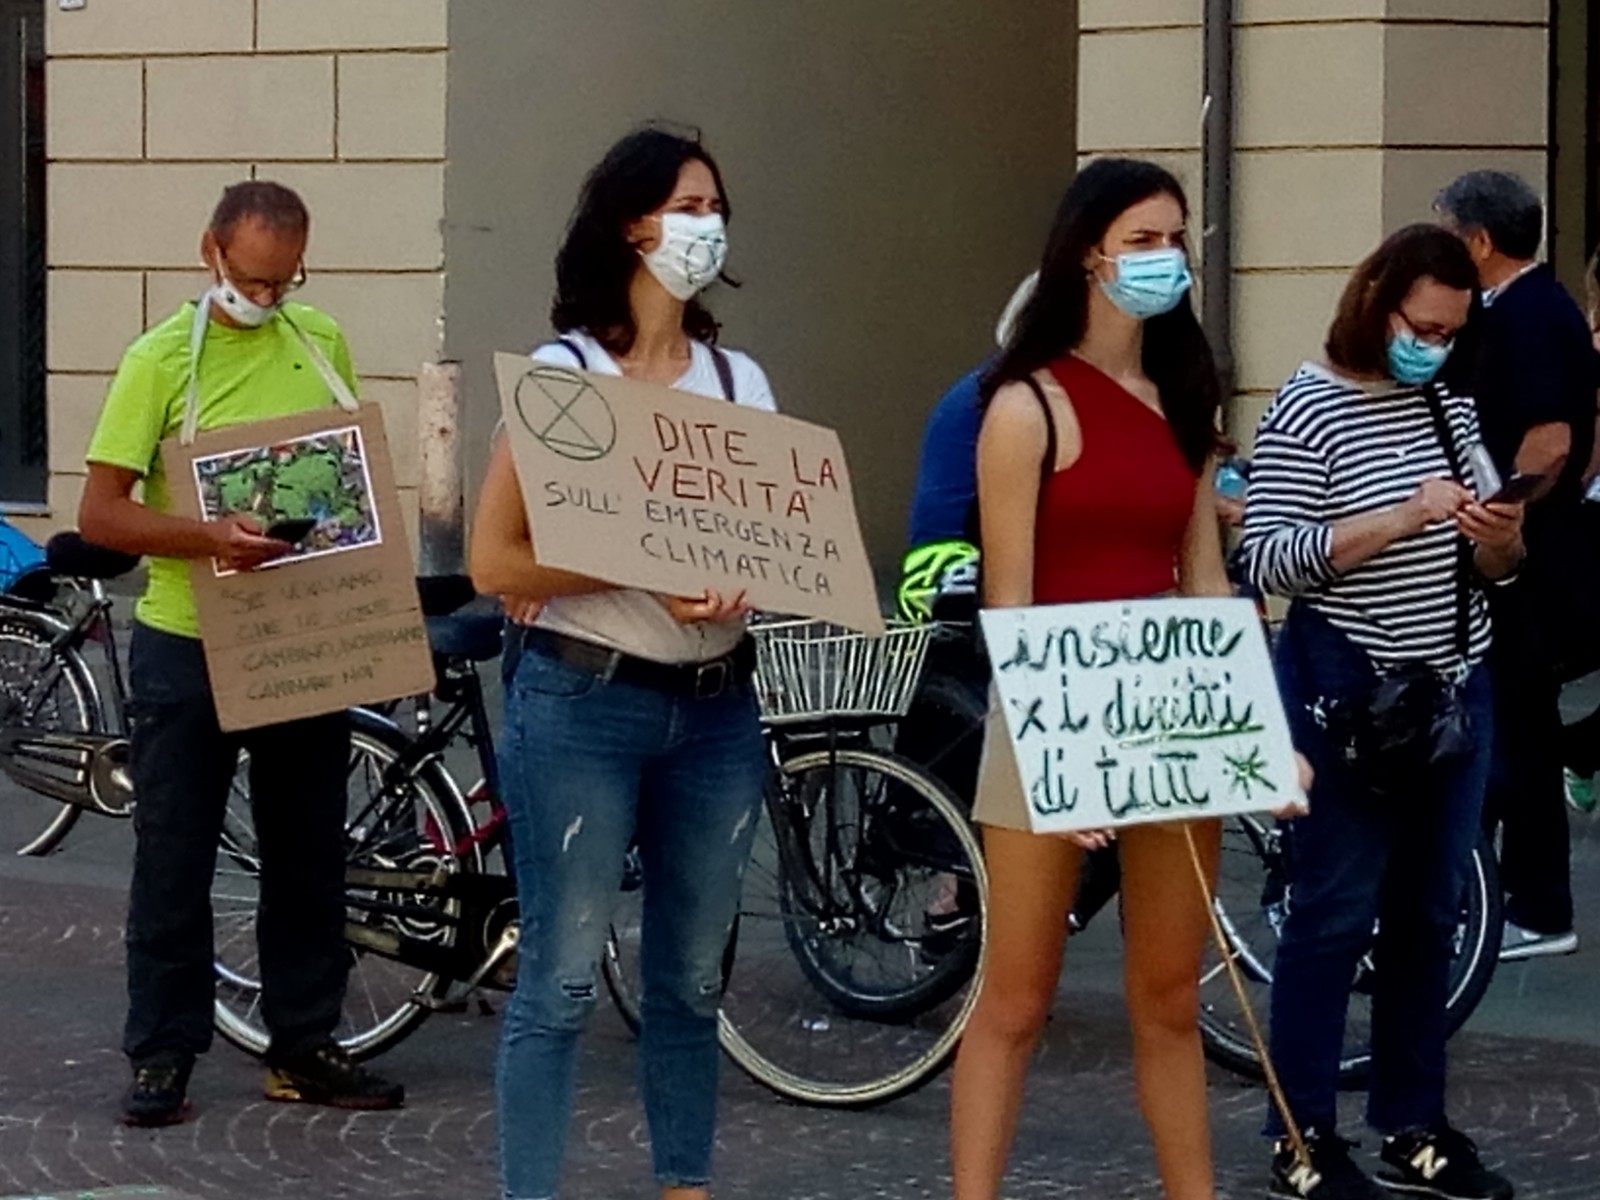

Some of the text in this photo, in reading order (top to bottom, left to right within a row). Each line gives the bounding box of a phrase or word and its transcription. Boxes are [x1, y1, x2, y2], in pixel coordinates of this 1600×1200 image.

[653, 413, 838, 491] DITE LA
[545, 481, 841, 561] SULL' EMERGENZA
[641, 533, 832, 596] CLIMATICA
[999, 607, 1244, 672] insieme
[1059, 674, 1088, 732] i
[1103, 669, 1252, 739] diritti
[1032, 748, 1078, 814] di
[1288, 1164, 1322, 1196] N
[1411, 1146, 1448, 1180] N
